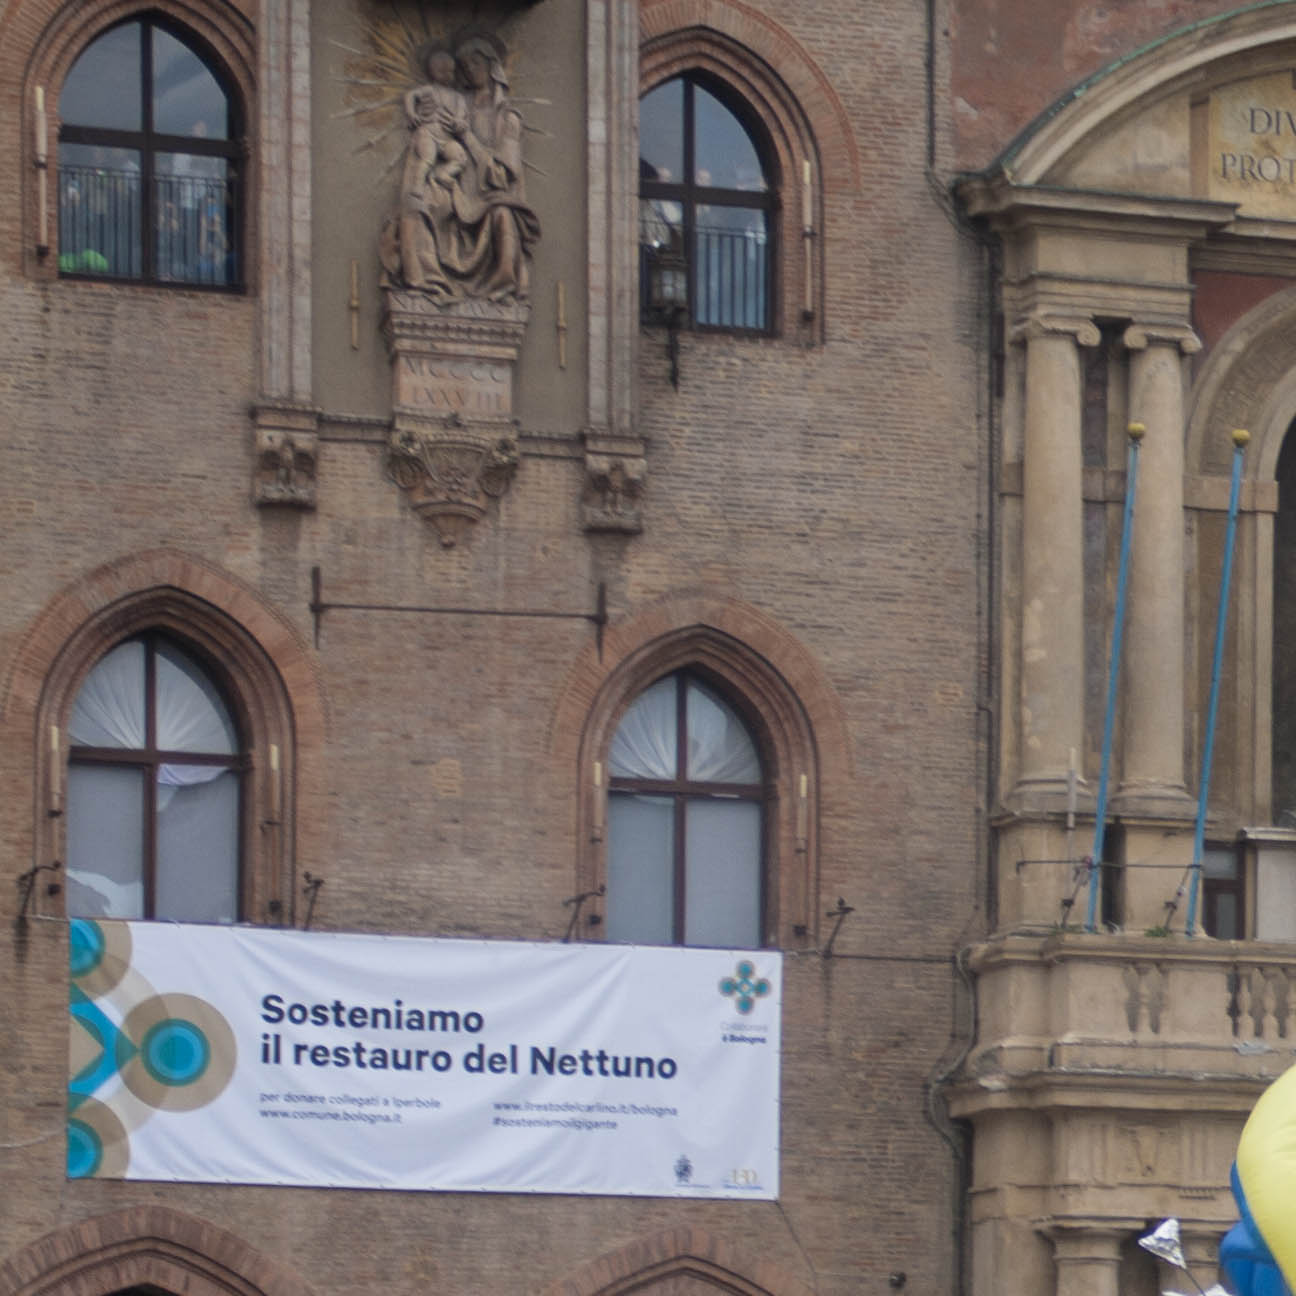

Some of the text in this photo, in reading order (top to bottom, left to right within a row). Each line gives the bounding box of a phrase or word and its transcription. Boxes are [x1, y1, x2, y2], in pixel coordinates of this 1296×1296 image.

[261, 994, 484, 1033] Sosteniamo
[261, 1033, 678, 1080] il restauro del Nettuno
[259, 1092, 280, 1103] per
[283, 1091, 326, 1105] donare
[329, 1094, 379, 1108] collegati
